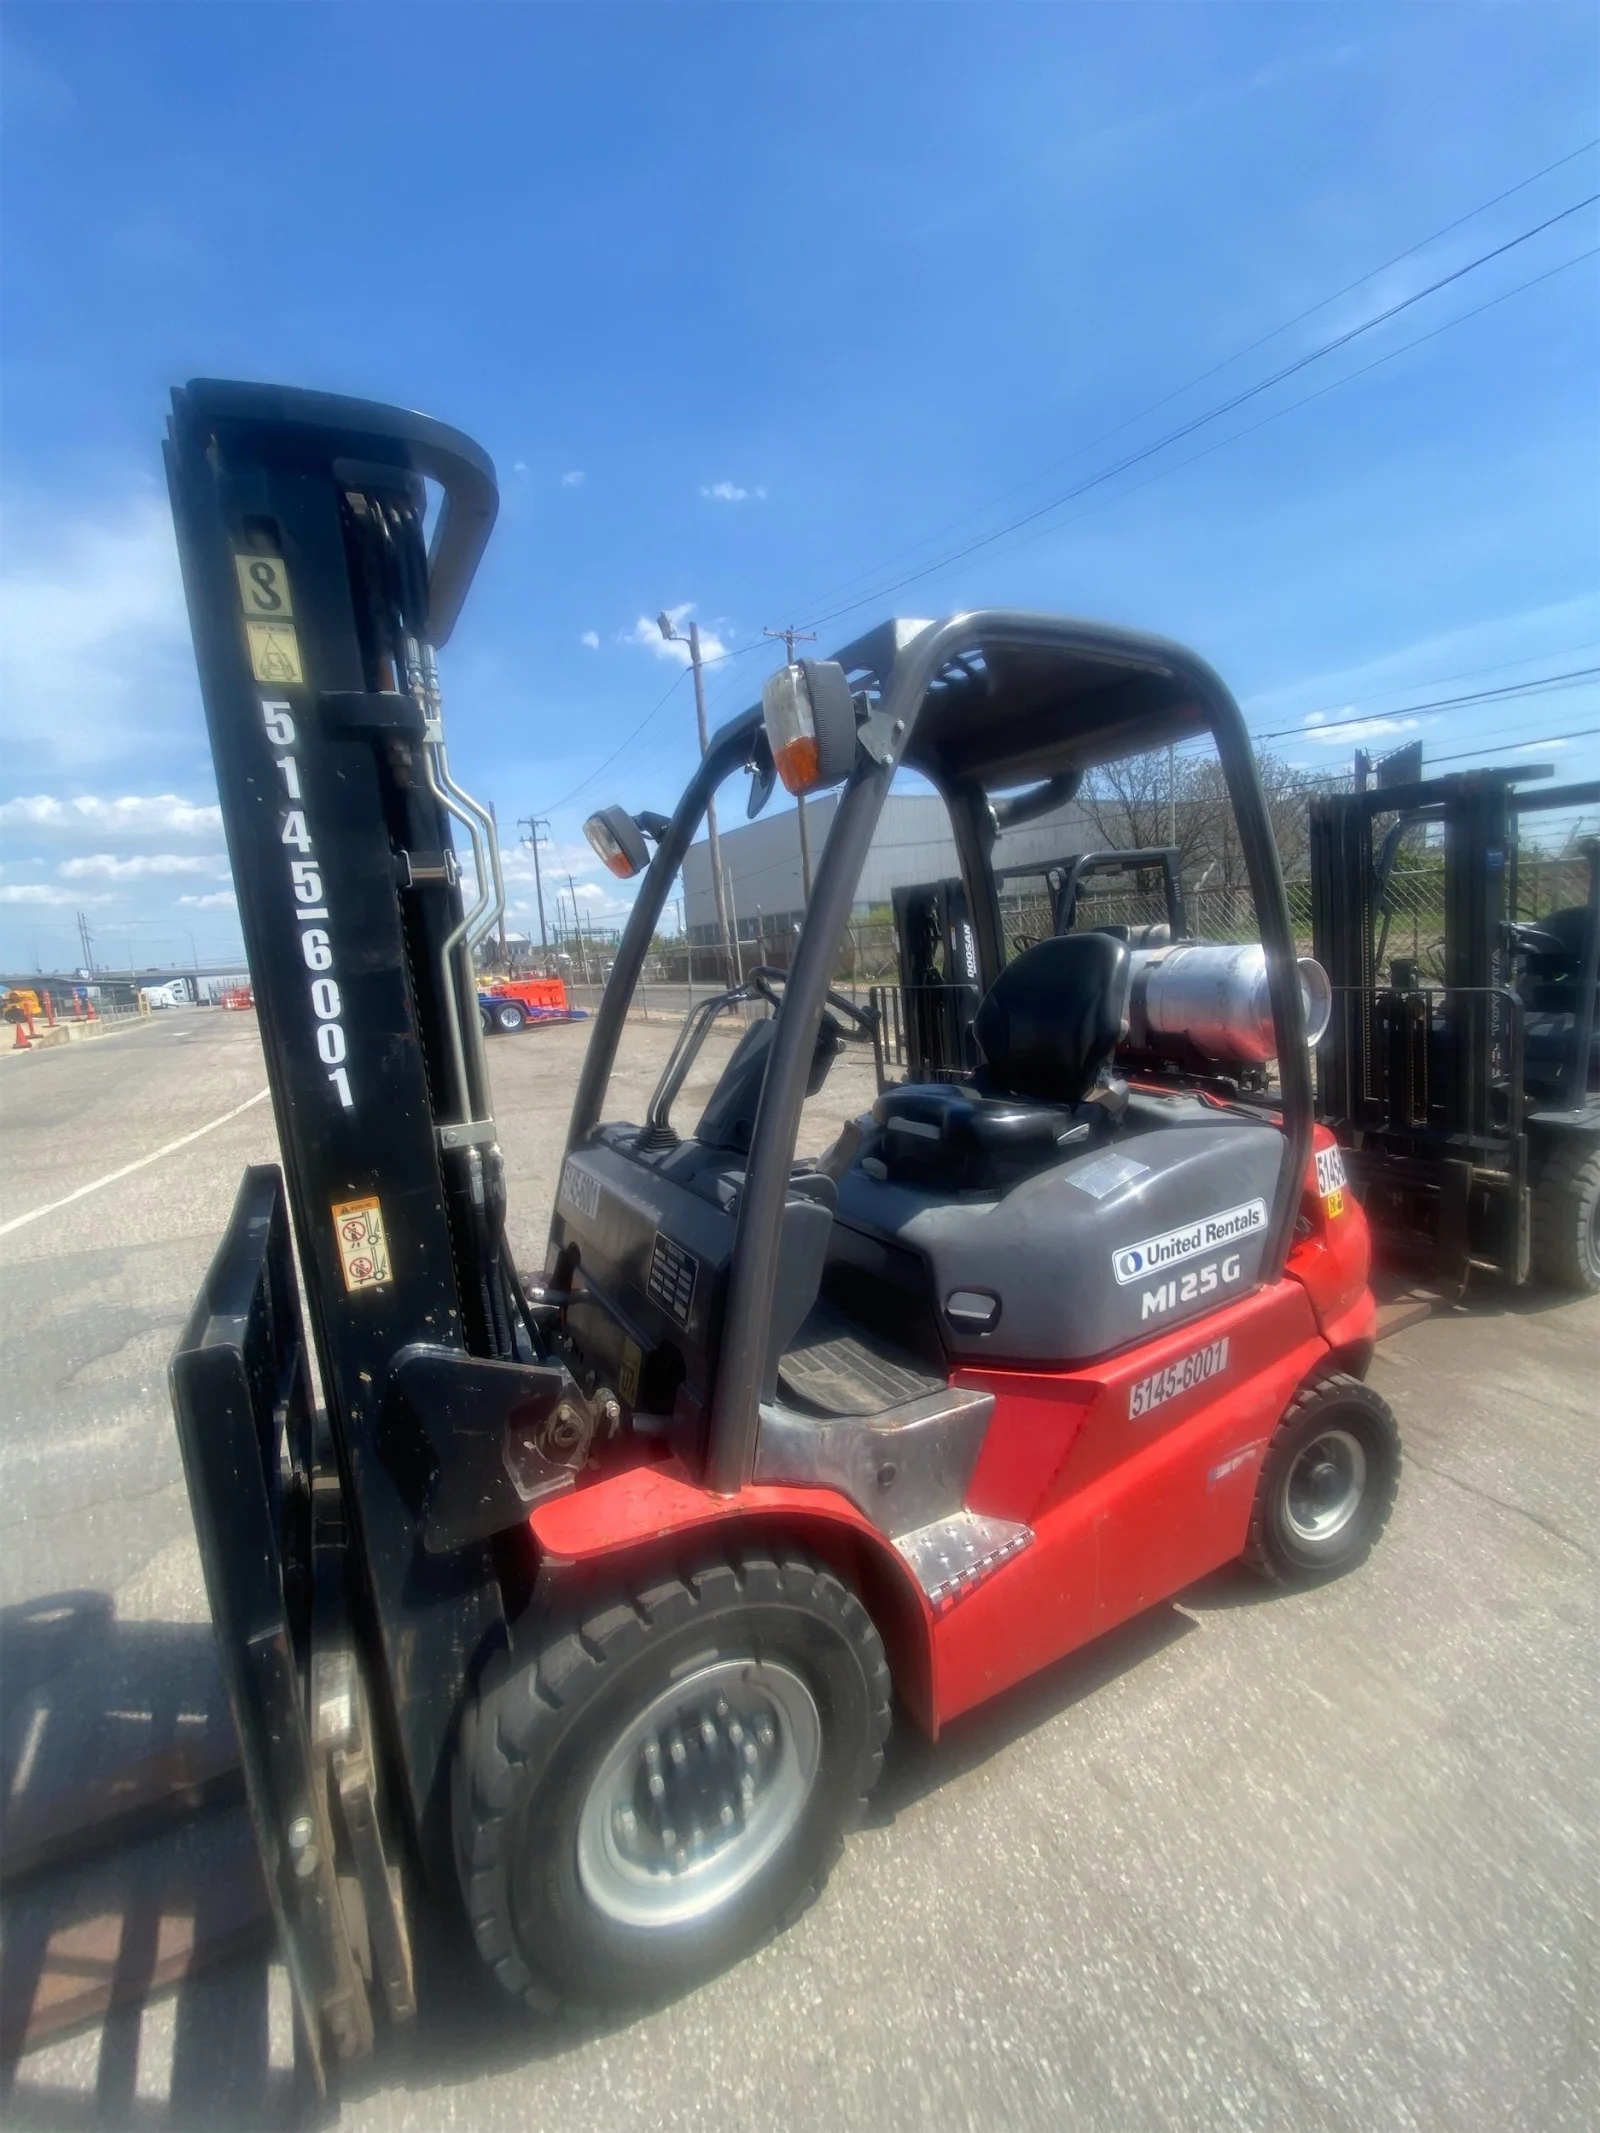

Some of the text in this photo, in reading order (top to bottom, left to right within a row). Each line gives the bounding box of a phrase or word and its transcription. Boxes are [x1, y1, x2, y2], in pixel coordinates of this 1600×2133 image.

[261, 700, 353, 1108] 5145-6001
[963, 924, 975, 978] DOOSAN
[1147, 1209, 1260, 1265] United Rentals
[1132, 1340, 1223, 1416] 5145-6001
